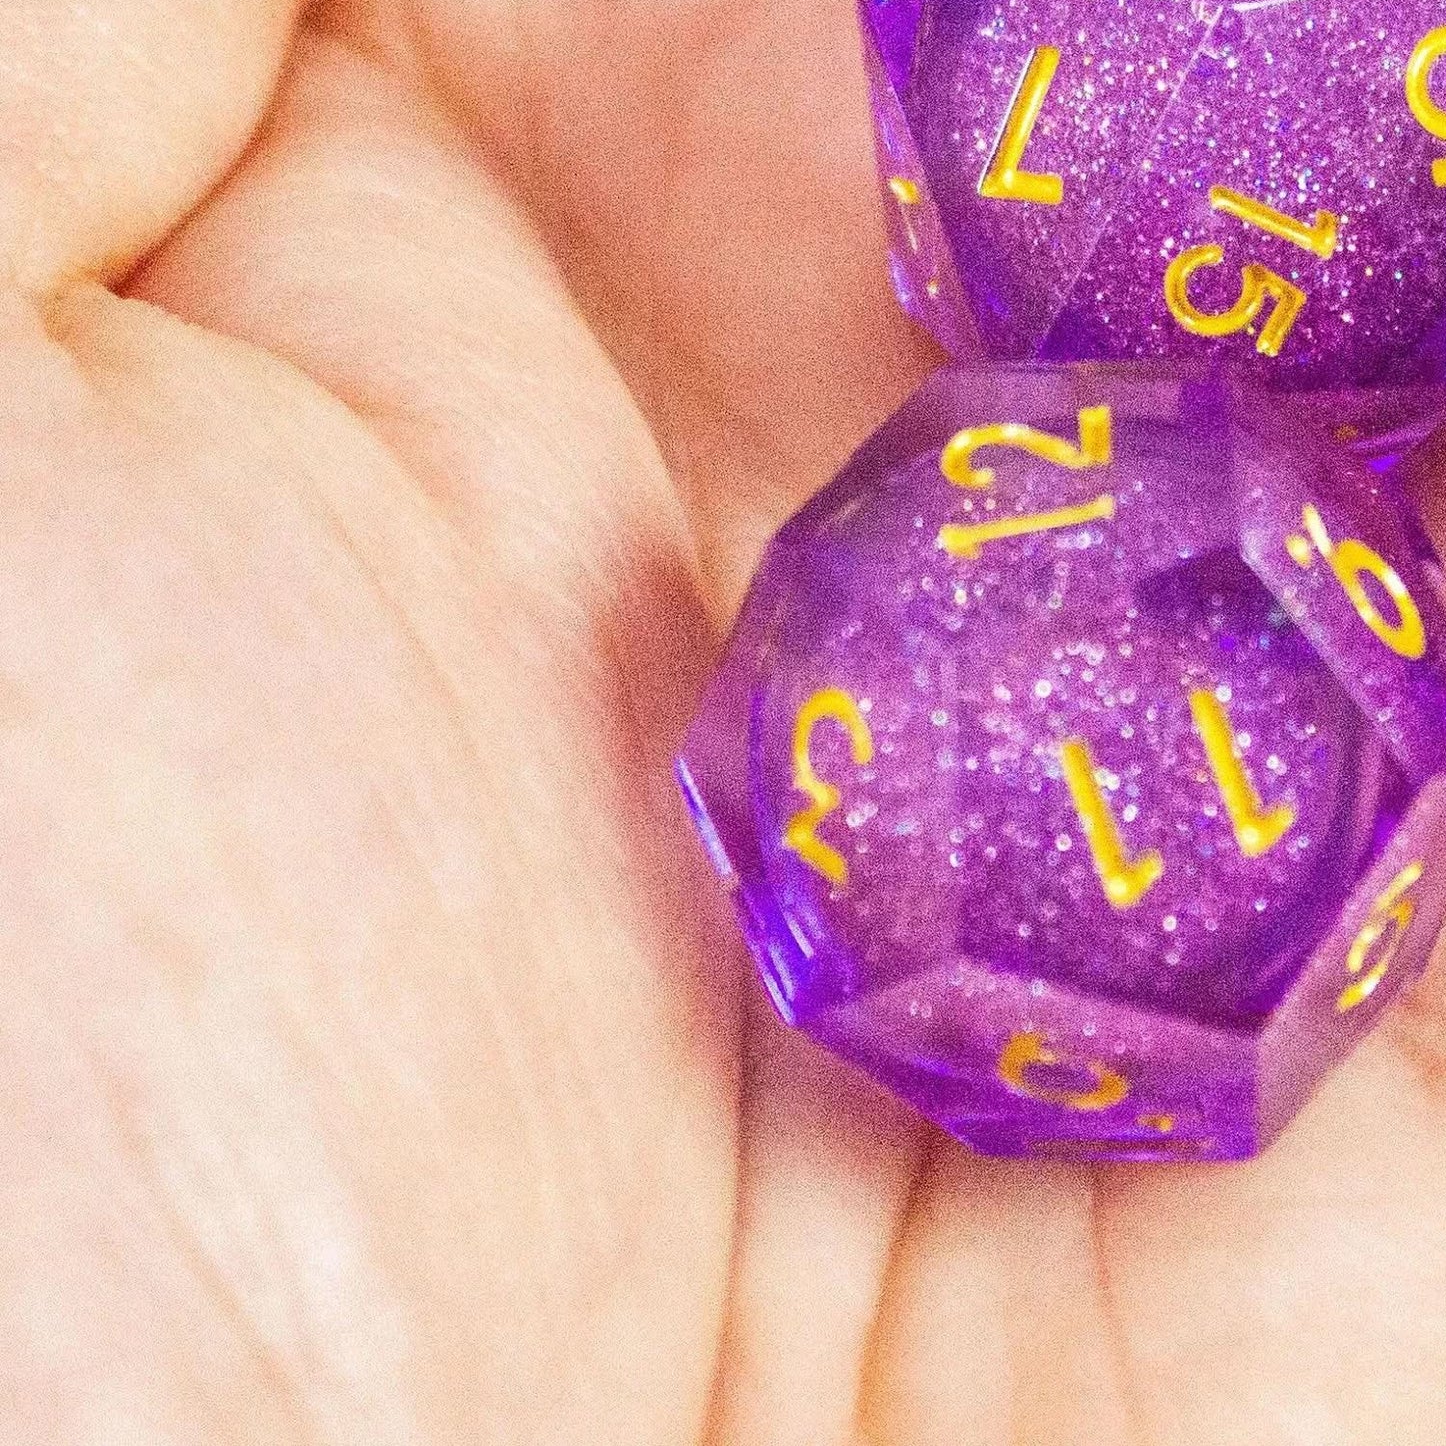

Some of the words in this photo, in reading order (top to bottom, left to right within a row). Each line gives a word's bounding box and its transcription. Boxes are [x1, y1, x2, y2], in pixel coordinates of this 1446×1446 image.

[976, 46, 1064, 205] 7
[1163, 185, 1339, 358] 15
[937, 404, 1114, 560] 12
[784, 687, 873, 887] 3
[1060, 688, 1294, 908] 11
